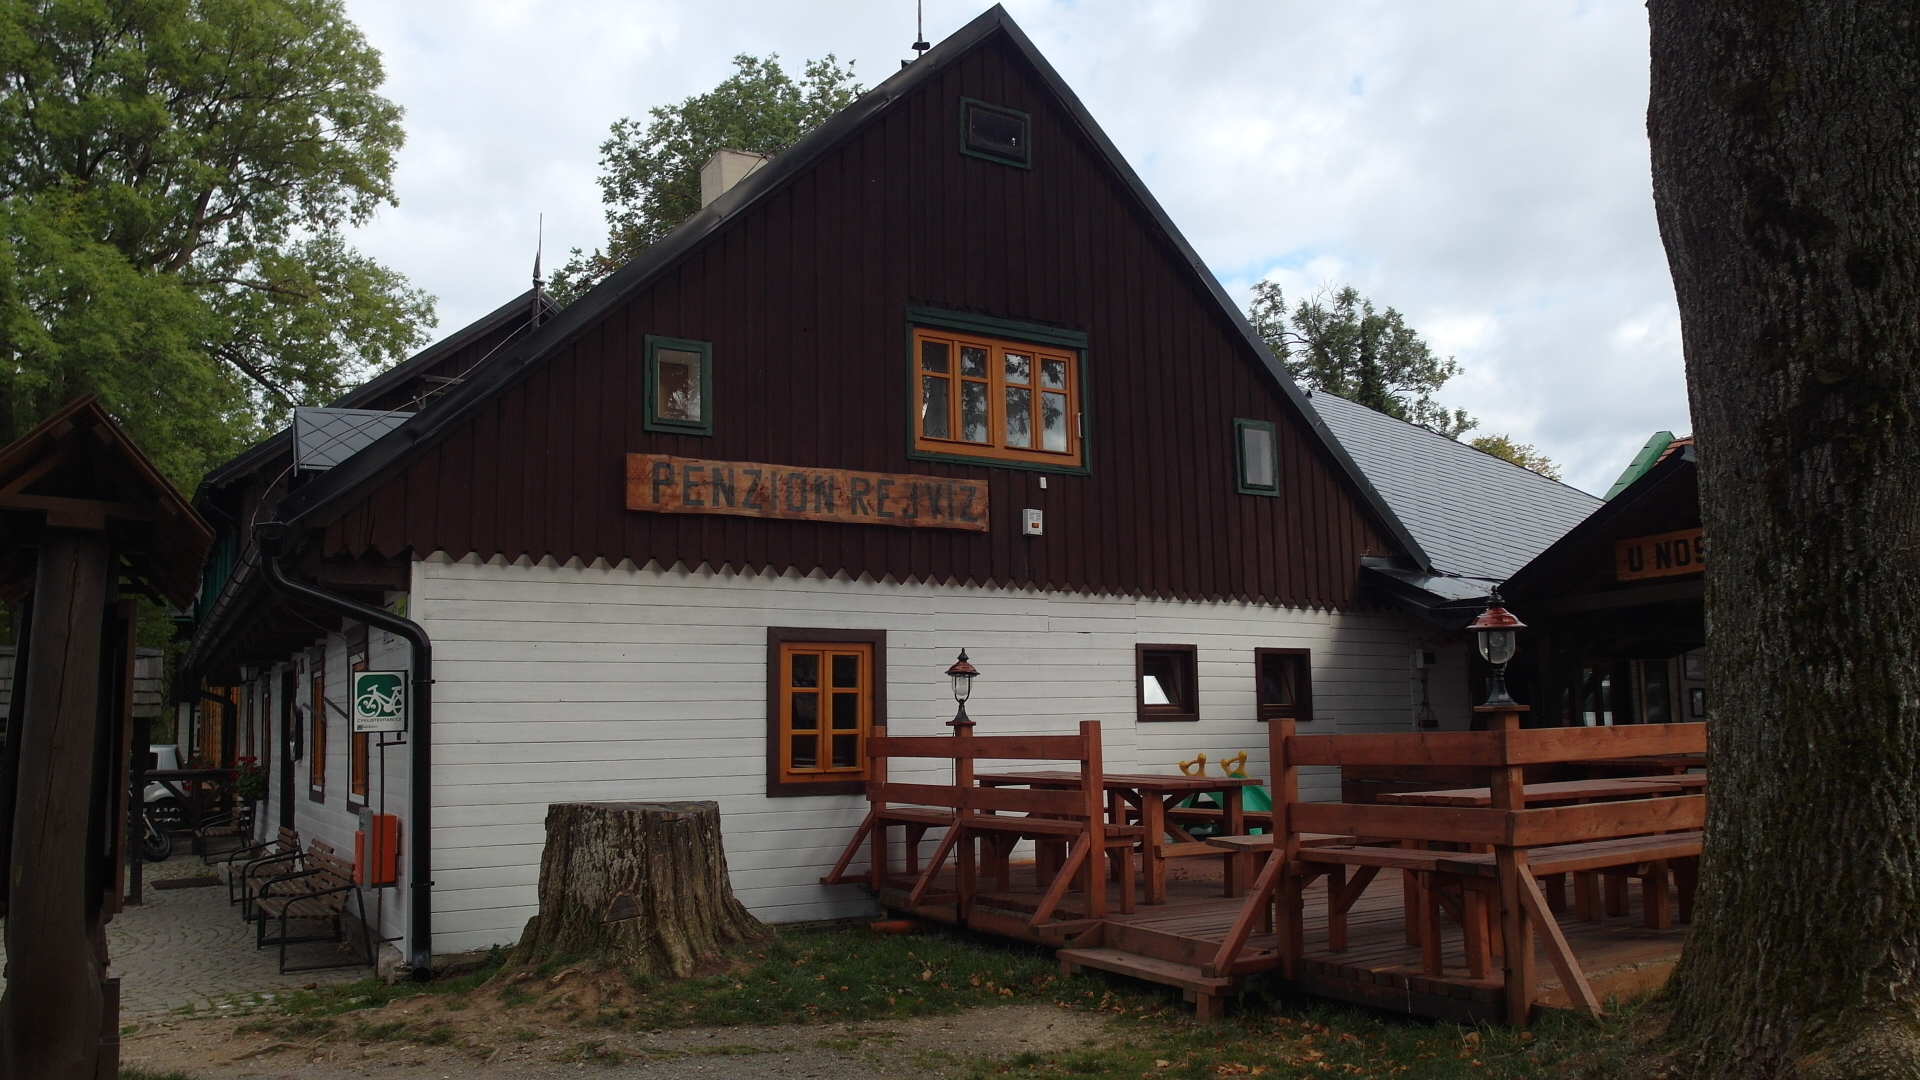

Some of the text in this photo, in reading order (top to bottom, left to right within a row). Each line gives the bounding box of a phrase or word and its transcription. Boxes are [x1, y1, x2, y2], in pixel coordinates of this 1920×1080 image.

[652, 461, 978, 522] PENZION REJVÍZ
[1628, 545, 1643, 572] U
